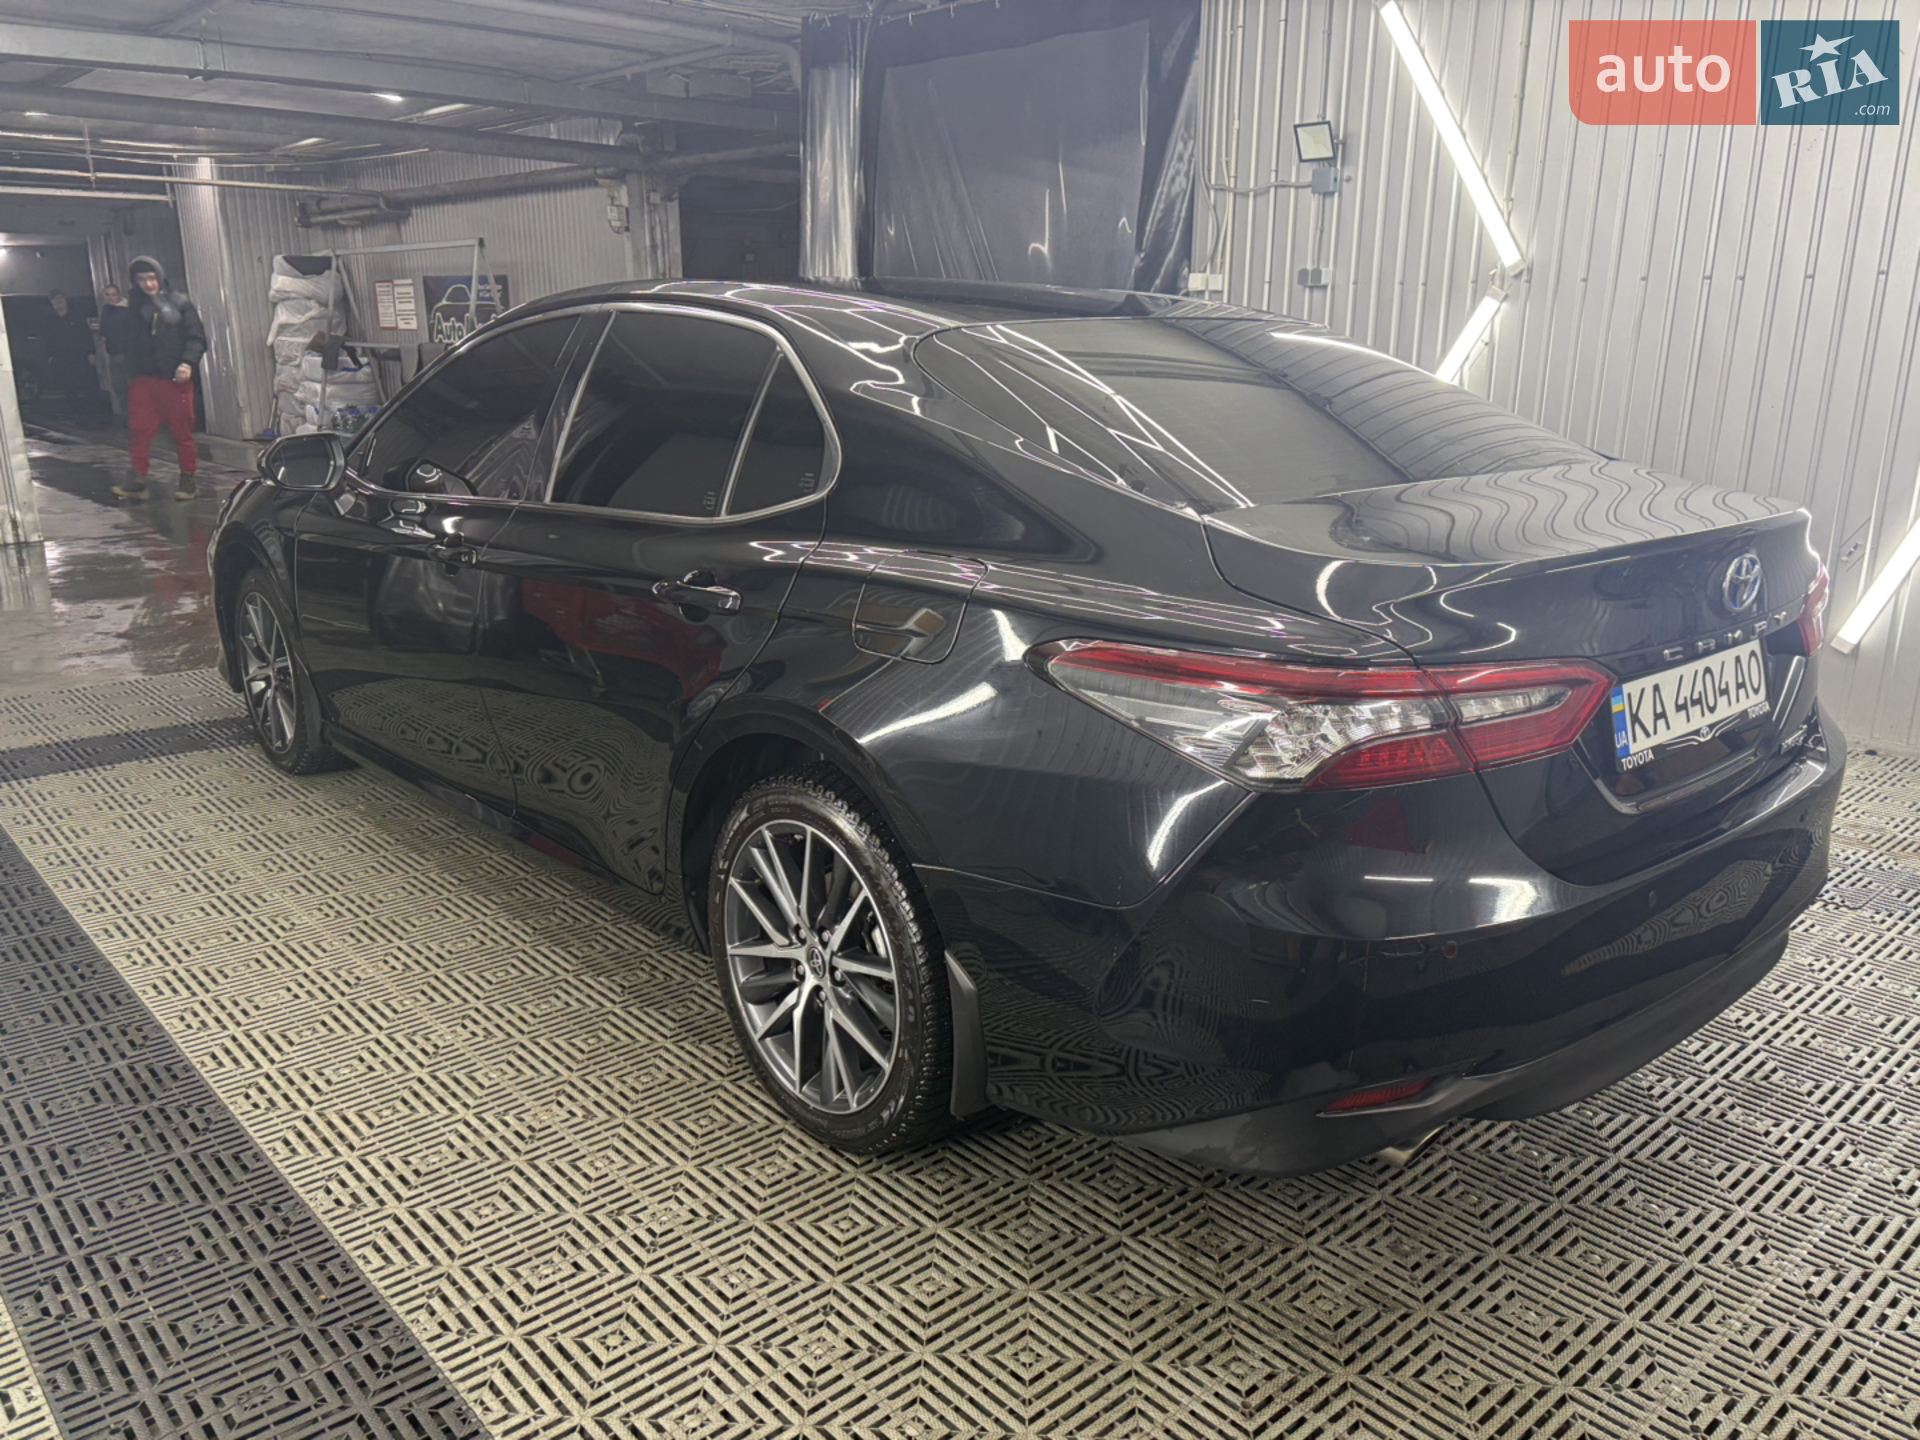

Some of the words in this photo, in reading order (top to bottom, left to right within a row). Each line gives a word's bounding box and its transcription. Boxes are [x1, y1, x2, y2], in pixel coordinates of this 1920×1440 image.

[1662, 611, 1787, 661] CAMRY
[1627, 683, 1671, 745] KA
[1674, 660, 1733, 723] 4404
[1735, 649, 1763, 704] AO
[1747, 701, 1771, 719] TOYOTA
[1614, 731, 1628, 749] UA
[1621, 749, 1655, 771] TOYOTA
